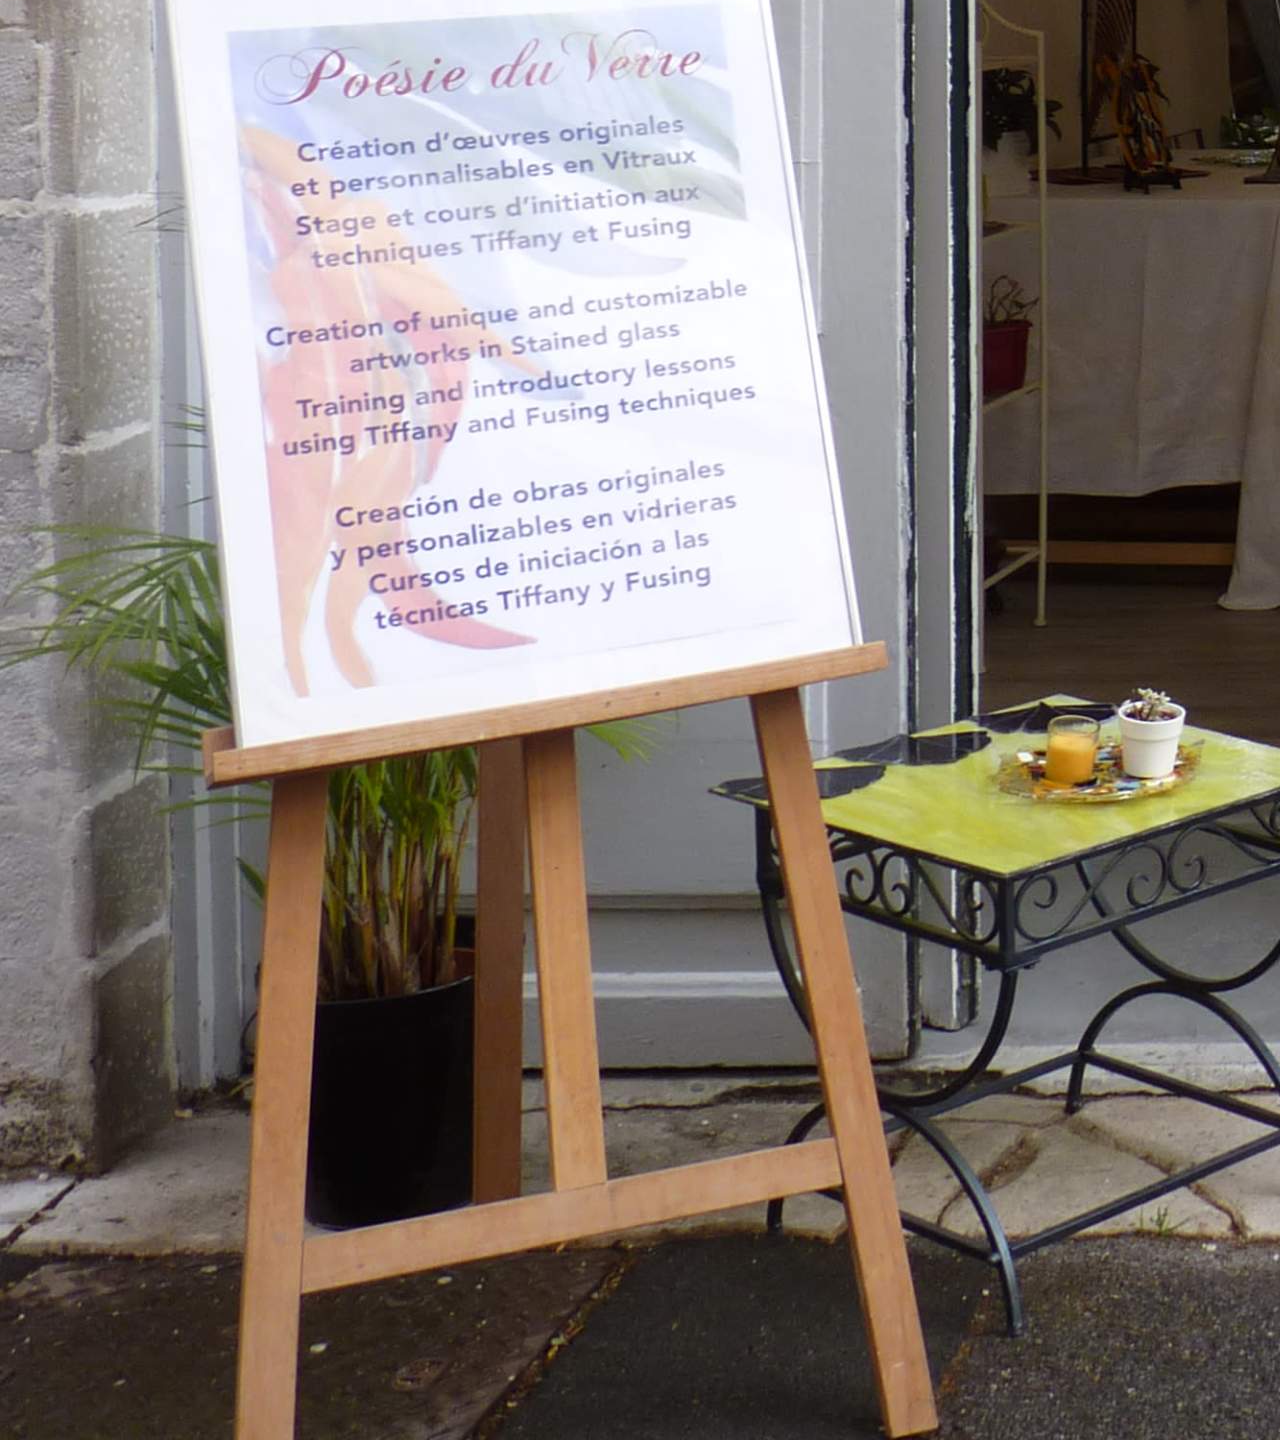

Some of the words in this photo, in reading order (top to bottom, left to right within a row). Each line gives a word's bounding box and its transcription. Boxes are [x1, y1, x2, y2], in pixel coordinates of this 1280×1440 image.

[254, 46, 474, 106] Poésie
[490, 37, 562, 89] du
[560, 28, 707, 82] Verre
[297, 138, 416, 163] Création
[559, 115, 685, 145] originales
[291, 177, 319, 198] et
[330, 158, 555, 200] personnalisables
[563, 158, 595, 174] en
[602, 149, 698, 170] Vitraux
[295, 215, 377, 237] Stage
[386, 209, 415, 227] et
[424, 204, 497, 224] cours
[505, 188, 647, 218] d'initiation
[654, 185, 701, 204] aux
[311, 241, 464, 269] techniques
[470, 230, 563, 253] Tiffany
[572, 226, 600, 244] et
[608, 217, 693, 241] Fusing
[266, 319, 384, 347] Creation
[393, 311, 422, 335] of
[430, 307, 519, 330] unique
[528, 295, 575, 320] and
[584, 278, 748, 314] customizable
[350, 342, 471, 374] artworks
[479, 339, 503, 359] in
[510, 325, 609, 356] Stained
[617, 321, 681, 349] glass
[296, 392, 406, 419] Training
[415, 381, 464, 406] and
[473, 365, 637, 399] introductory
[645, 354, 737, 378] lessons
[283, 432, 356, 457] using
[364, 420, 458, 446] Tiffany
[467, 408, 515, 435] and
[526, 401, 610, 427] Fusing
[618, 384, 757, 416] techniques
[335, 495, 459, 528] Creación
[468, 487, 503, 510] de
[513, 480, 588, 504] obras
[597, 459, 726, 495] originales
[330, 548, 346, 572] y
[357, 514, 573, 567] personalizables
[582, 511, 614, 529] en
[622, 493, 738, 524] vidrieras
[368, 567, 466, 595] Cursos
[475, 556, 509, 580] de
[518, 538, 643, 574] iniciación
[651, 538, 667, 554] a
[674, 529, 710, 551] las
[373, 599, 489, 630] técnicas
[496, 583, 591, 612] Tiffany
[600, 581, 615, 603] y
[625, 565, 713, 593] Fusing
